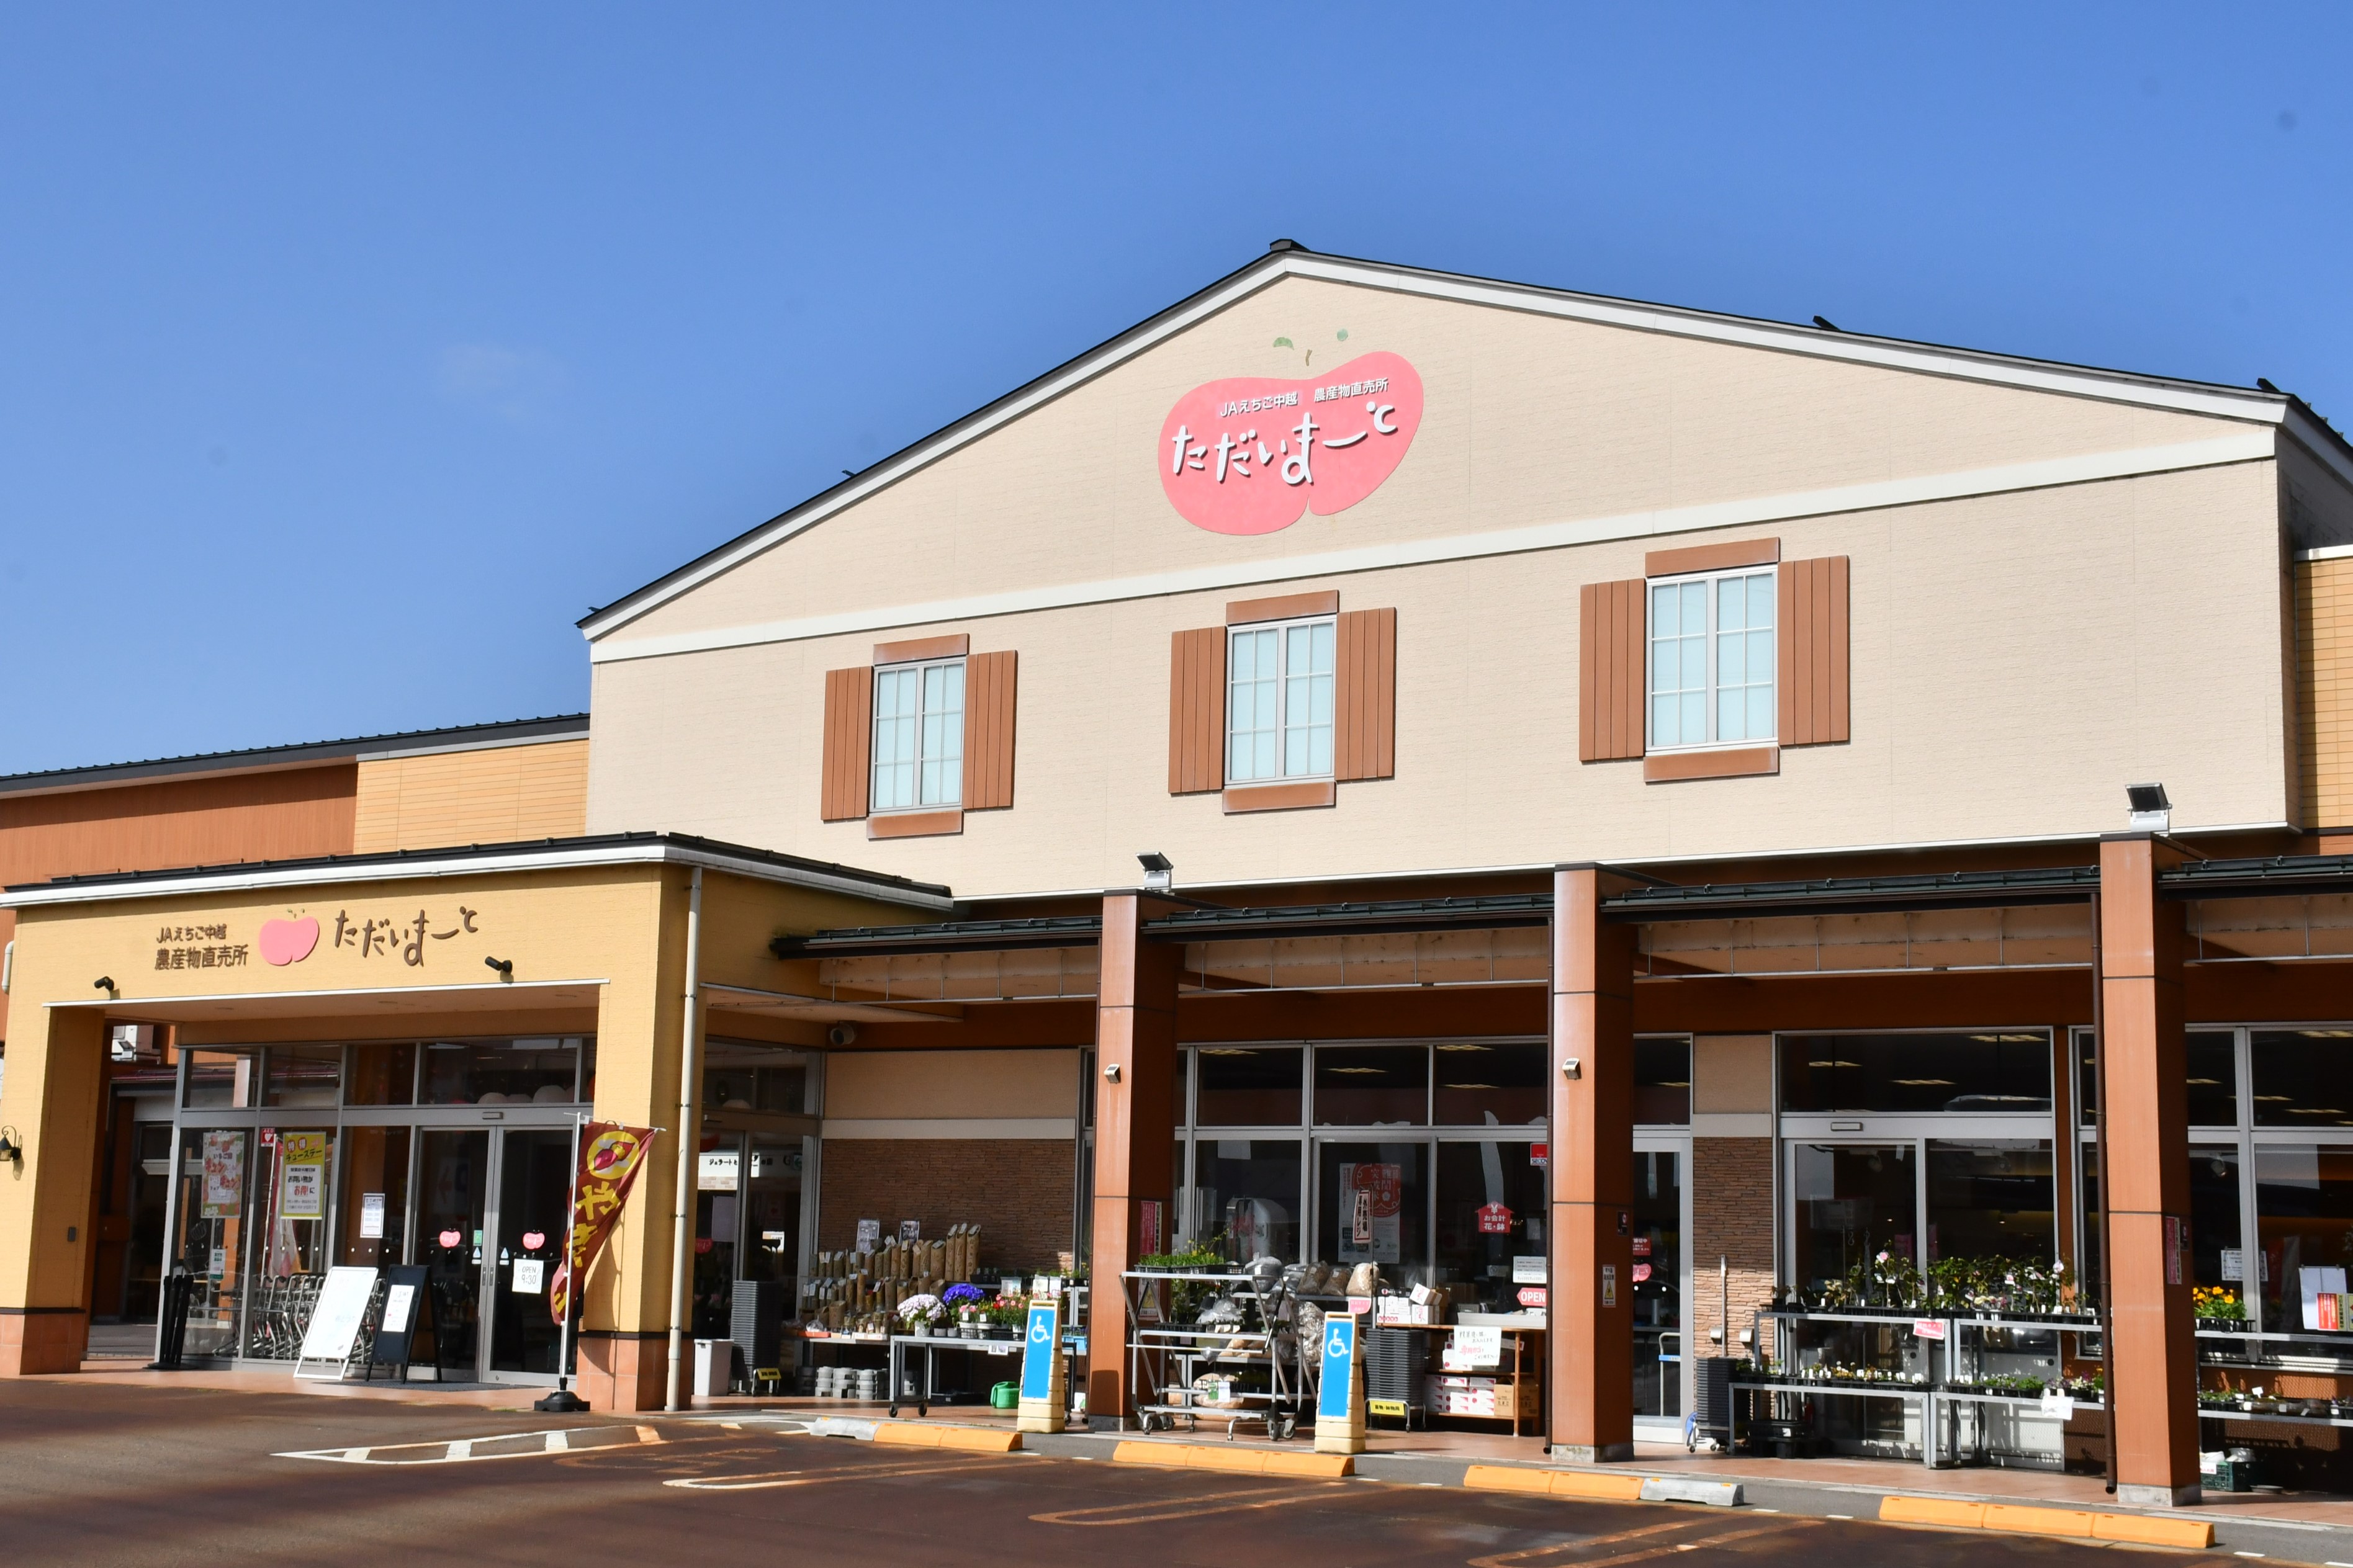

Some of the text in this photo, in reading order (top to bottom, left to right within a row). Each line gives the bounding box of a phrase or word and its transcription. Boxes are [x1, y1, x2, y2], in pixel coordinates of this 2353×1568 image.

[1313, 377, 1389, 403] 農産物直売所
[1220, 391, 1298, 418] JAえちご中越
[1172, 401, 1398, 485] ただいまーと
[156, 923, 227, 944] JAえちご中越
[335, 906, 479, 967] ただいまーと
[155, 944, 248, 970] 農産物直売所
[521, 1275, 536, 1284] 9:30
[1521, 1291, 1546, 1303] OPEN
